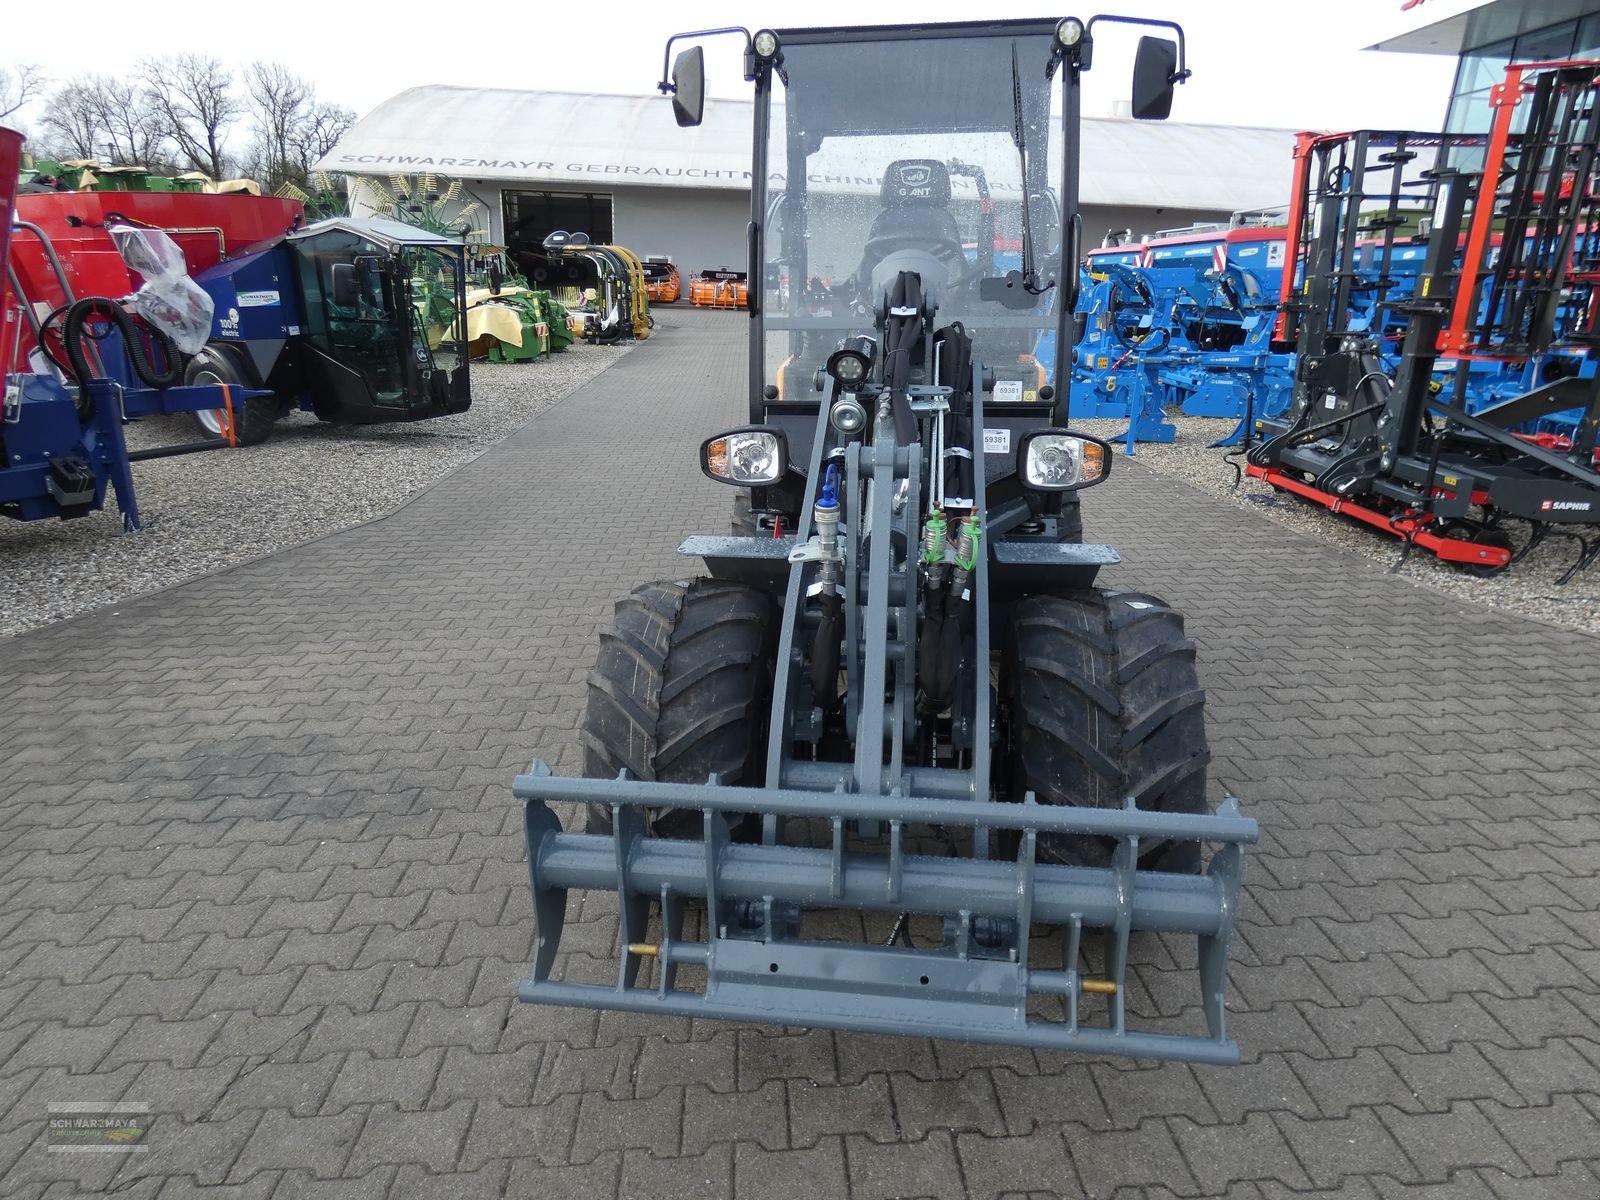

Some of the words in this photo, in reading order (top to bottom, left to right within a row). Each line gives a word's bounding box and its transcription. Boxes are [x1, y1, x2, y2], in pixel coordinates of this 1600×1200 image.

[339, 154, 555, 170] SCHWARZMAYR
[899, 187, 931, 196] GANT
[1552, 501, 1590, 510] SAPHIR
